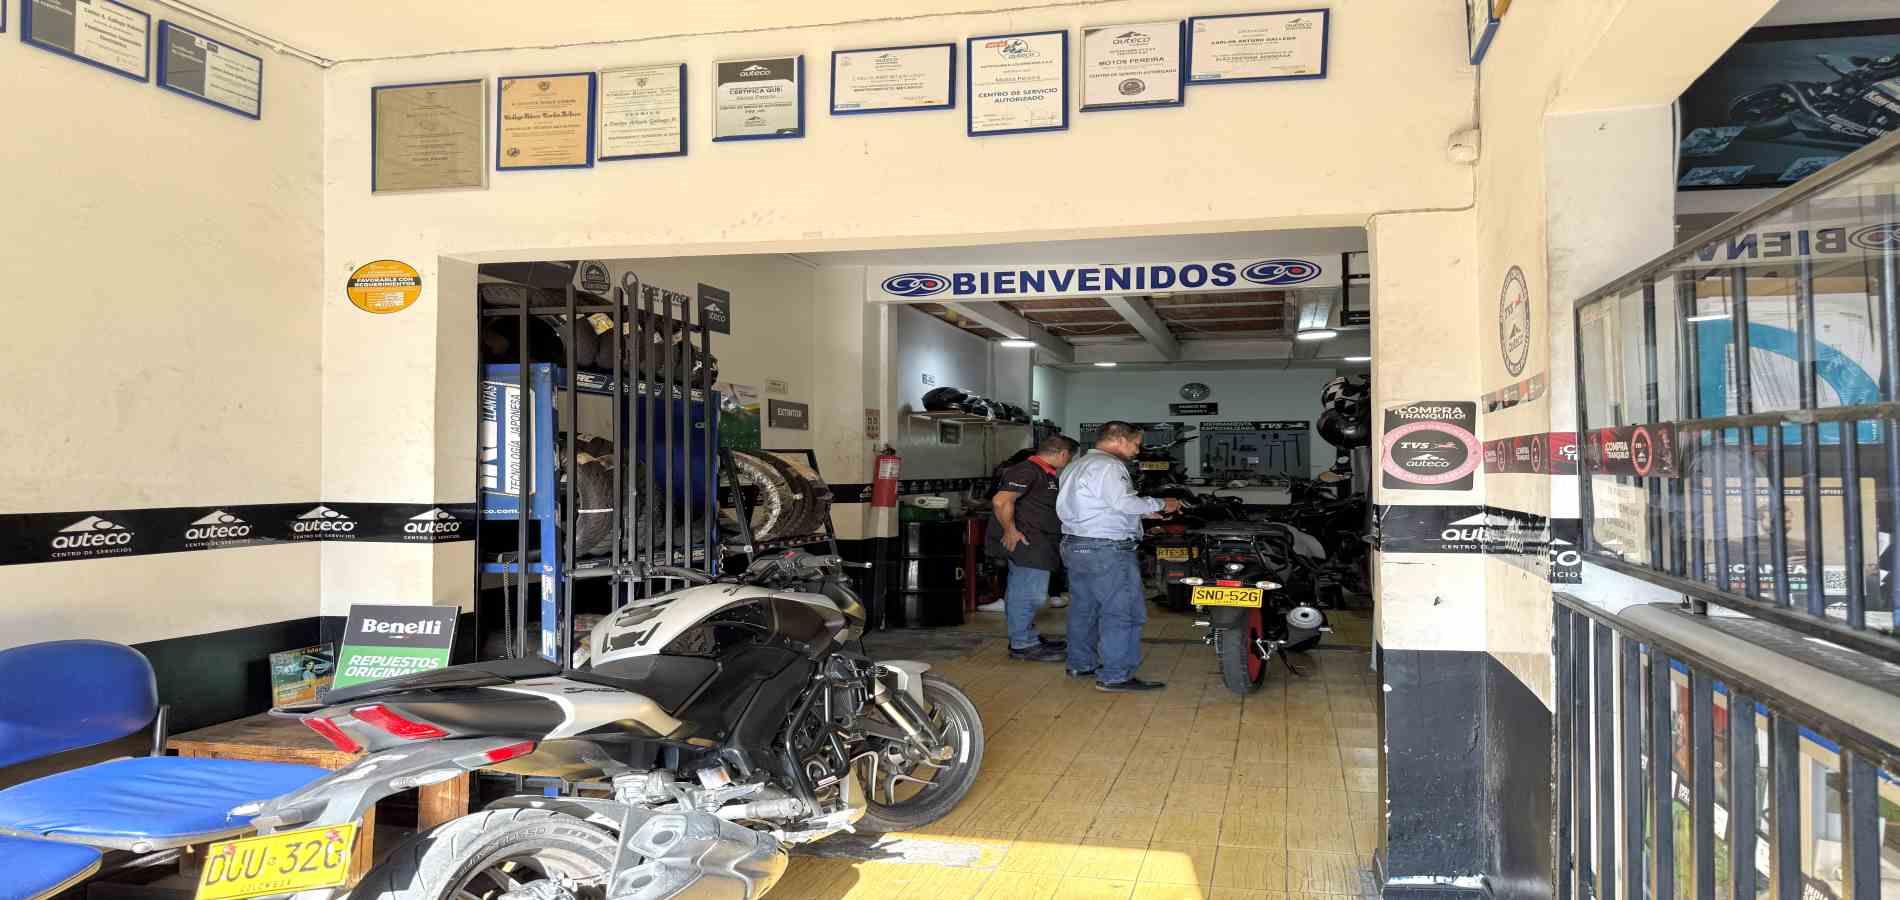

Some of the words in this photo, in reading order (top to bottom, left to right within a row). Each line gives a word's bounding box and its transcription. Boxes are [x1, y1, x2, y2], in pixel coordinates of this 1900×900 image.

[1113, 37, 1151, 45] auteco
[739, 69, 772, 77] auteco
[1023, 87, 1058, 96] SERVICIO
[994, 95, 1043, 103] AUTORIZADO
[952, 262, 1236, 295] BIENVENIDOS
[1394, 406, 1464, 415] ¡COMPRA
[1400, 441, 1431, 449] TVS
[1406, 460, 1450, 468] auteco
[294, 519, 355, 533] auteco
[404, 520, 460, 533] auteco
[185, 525, 250, 540] auteco
[52, 532, 131, 549] auteco
[51, 551, 82, 559] CENTRO
[96, 547, 133, 555] SERVICIOS
[361, 618, 441, 635] Benelli
[347, 655, 441, 669] REPUESTOS
[345, 666, 428, 678] ORIGINA
